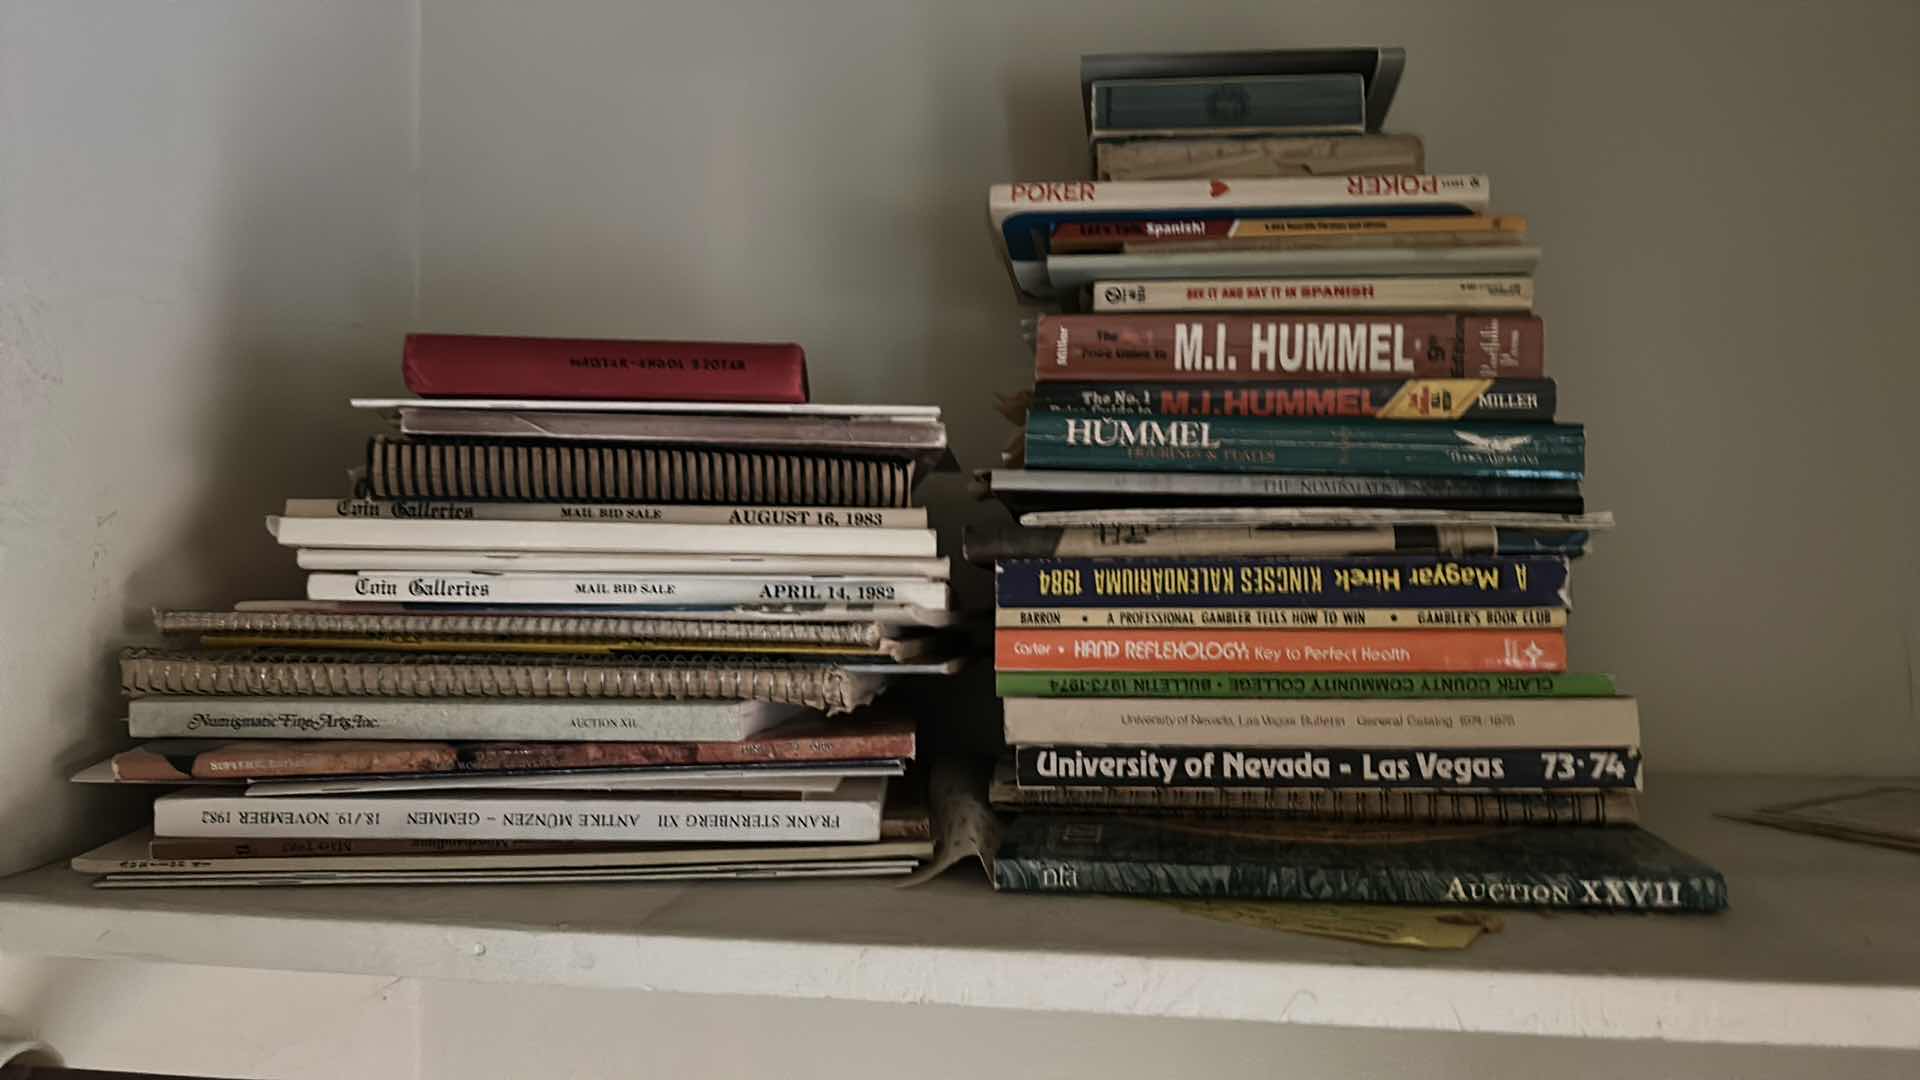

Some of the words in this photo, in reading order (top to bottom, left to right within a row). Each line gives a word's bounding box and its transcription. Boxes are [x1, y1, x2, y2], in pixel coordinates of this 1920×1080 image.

[1011, 181, 1096, 203] POKER
[1346, 174, 1440, 196] POKER
[1222, 287, 1244, 300] AND
[1301, 284, 1375, 299] SPANISH
[1173, 322, 1238, 372] M.I.
[1250, 322, 1415, 373] HUMMEL
[1081, 391, 1112, 405] The
[1160, 391, 1222, 416] M.I.
[1223, 389, 1380, 416] HUMMEL
[1478, 391, 1538, 409] MILLER
[391, 500, 474, 520] Galleries
[560, 506, 592, 519] MAIL
[599, 507, 624, 519] BID
[625, 508, 662, 520] SALE
[729, 508, 811, 526] AUGUST
[815, 510, 840, 527] 16,
[846, 510, 883, 527] 1983
[1039, 568, 1082, 595] 1984
[1241, 567, 1322, 594] KINCSES
[1409, 563, 1499, 591] Magyar
[408, 578, 490, 597] Galleries
[575, 582, 609, 595] MAIL
[614, 583, 637, 595] BID
[640, 583, 676, 595] SALE
[760, 583, 821, 599] APRIL
[827, 585, 850, 600] 14,
[857, 585, 896, 600] 1982
[1020, 611, 1061, 624] BARRON
[1107, 611, 1114, 624] A
[1119, 611, 1194, 624] PROFESSIONAL
[1201, 611, 1250, 624] GAMBLER
[1256, 611, 1287, 624] TELLS
[1292, 611, 1318, 624] HOW
[1324, 611, 1338, 624] TO
[1342, 611, 1366, 624] WIN
[1417, 610, 1481, 624] GAMBLER'S
[1486, 610, 1518, 624] BOOK
[1522, 610, 1551, 624] CLUB
[1014, 641, 1051, 656] Carter
[1073, 639, 1120, 659] HAND
[1255, 645, 1281, 662] Key
[1285, 645, 1301, 660] to
[1305, 645, 1357, 662] Perfect
[1361, 646, 1411, 662] Health
[1135, 677, 1213, 692] BULLETIN
[1229, 677, 1305, 692] COLLEGE
[1311, 676, 1414, 692] COMMUNITY
[1421, 676, 1490, 691] COUNTY
[1497, 676, 1554, 690] CLARK
[1036, 750, 1178, 784] University
[1184, 752, 1215, 778] of
[1222, 752, 1330, 779] Nevada
[1362, 753, 1411, 782] Las
[1416, 752, 1506, 785] Vegas
[200, 811, 231, 824] 1982
[238, 811, 330, 826] NOVEMBER
[405, 813, 481, 826] GEMMEN
[577, 813, 641, 828] ANTIKE
[657, 814, 680, 828] XII
[686, 814, 781, 829] STERNBERG
[786, 814, 840, 829] FRANK
[1580, 879, 1682, 908] XXVII
